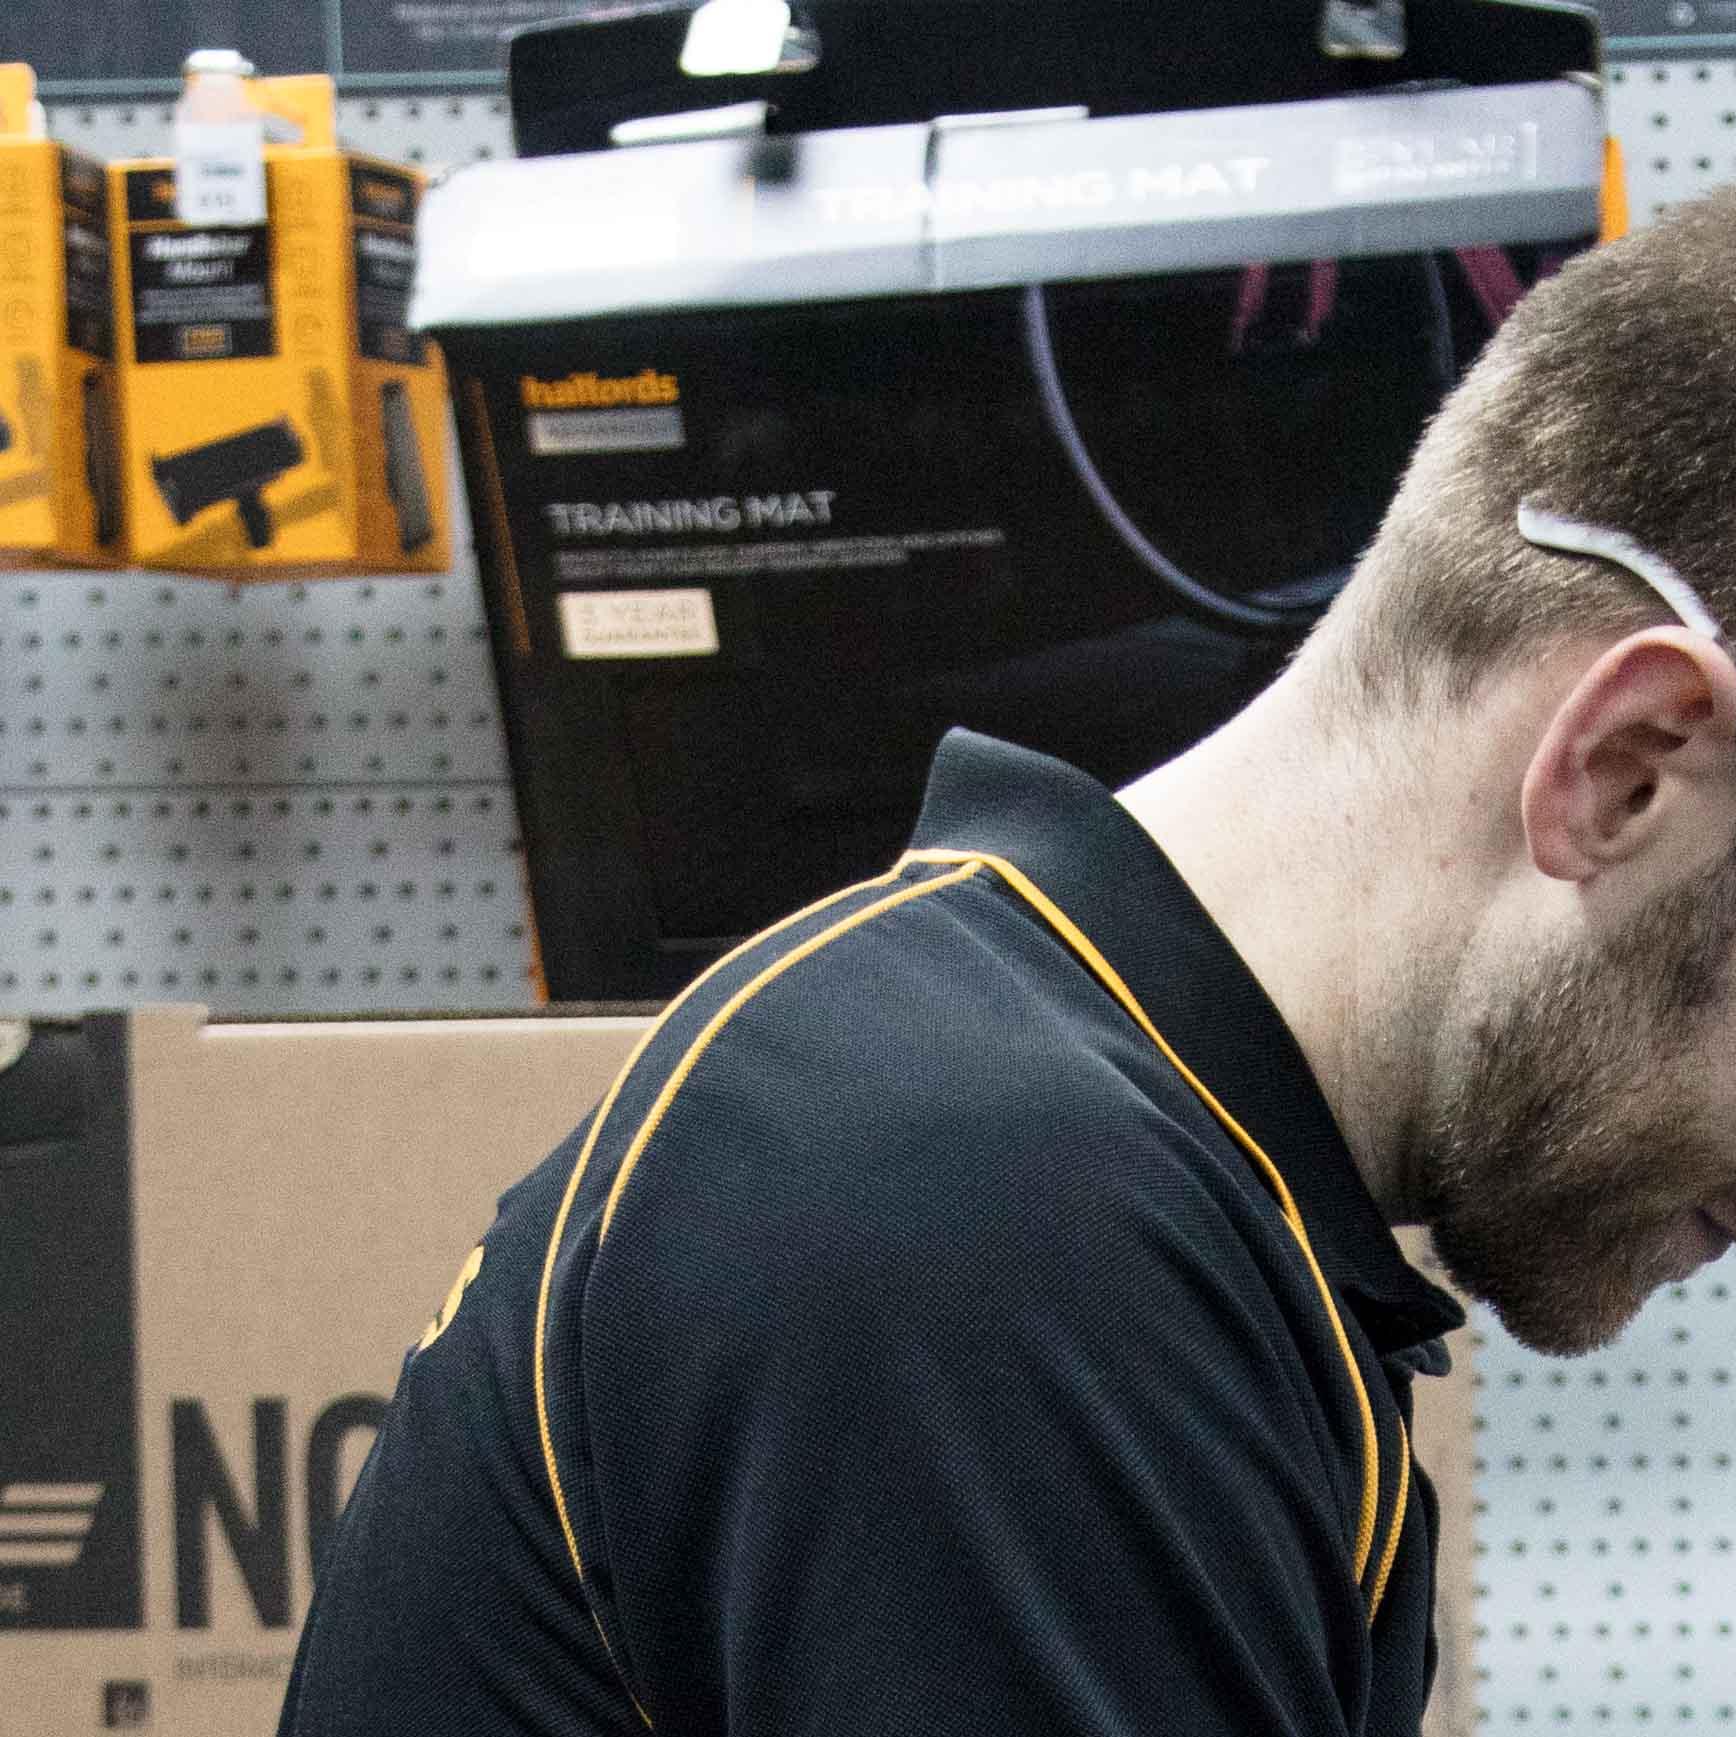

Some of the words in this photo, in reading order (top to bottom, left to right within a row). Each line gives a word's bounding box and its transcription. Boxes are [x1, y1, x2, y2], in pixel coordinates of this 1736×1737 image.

[1131, 156, 1272, 203] MAT
[545, 496, 740, 536] TRAINING
[744, 490, 837, 527] MAT
